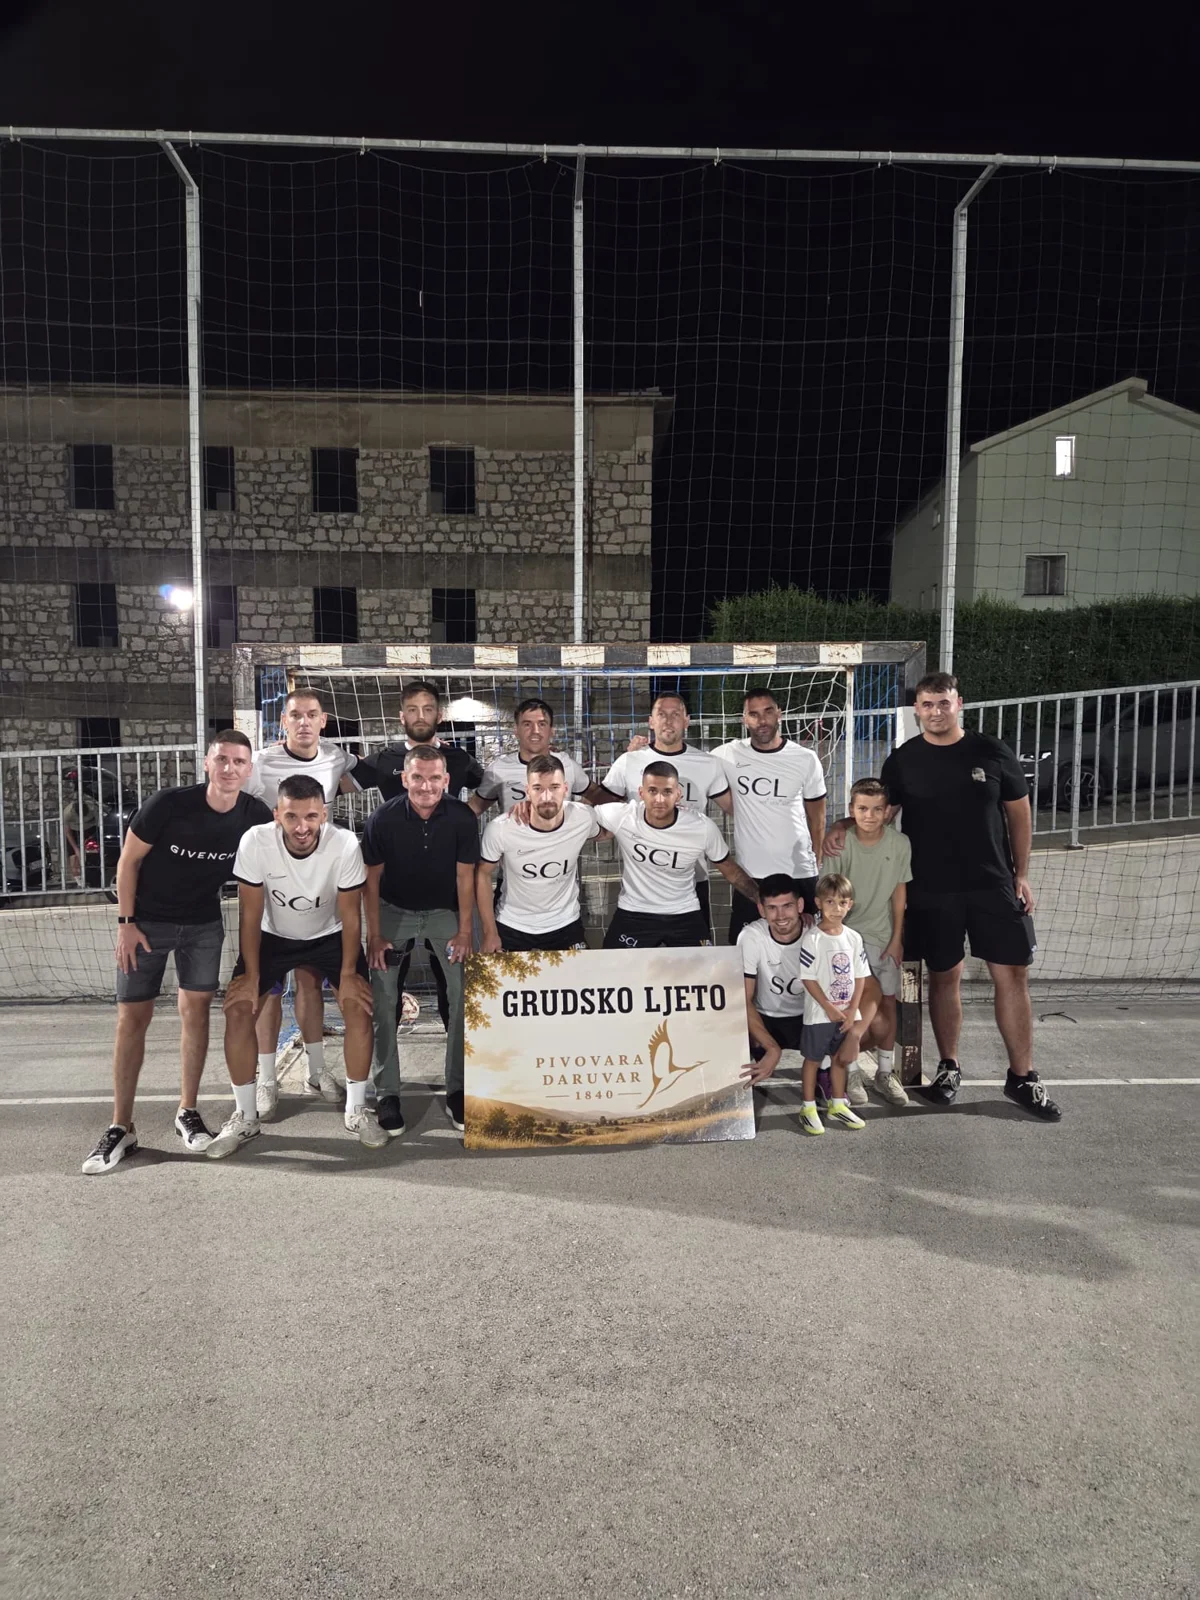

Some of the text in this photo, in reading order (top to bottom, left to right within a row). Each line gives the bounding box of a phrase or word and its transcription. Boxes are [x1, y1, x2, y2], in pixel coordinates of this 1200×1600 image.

[737, 775, 787, 798] SCL
[170, 844, 237, 861] GIVENCH
[632, 843, 685, 870] SCL
[770, 975, 804, 996] SC
[502, 984, 727, 1018] GRUDSKO LJETO
[535, 1054, 644, 1069] PIVOVARA
[542, 1071, 641, 1086] DARUVAR
[575, 1090, 613, 1100] 1840
